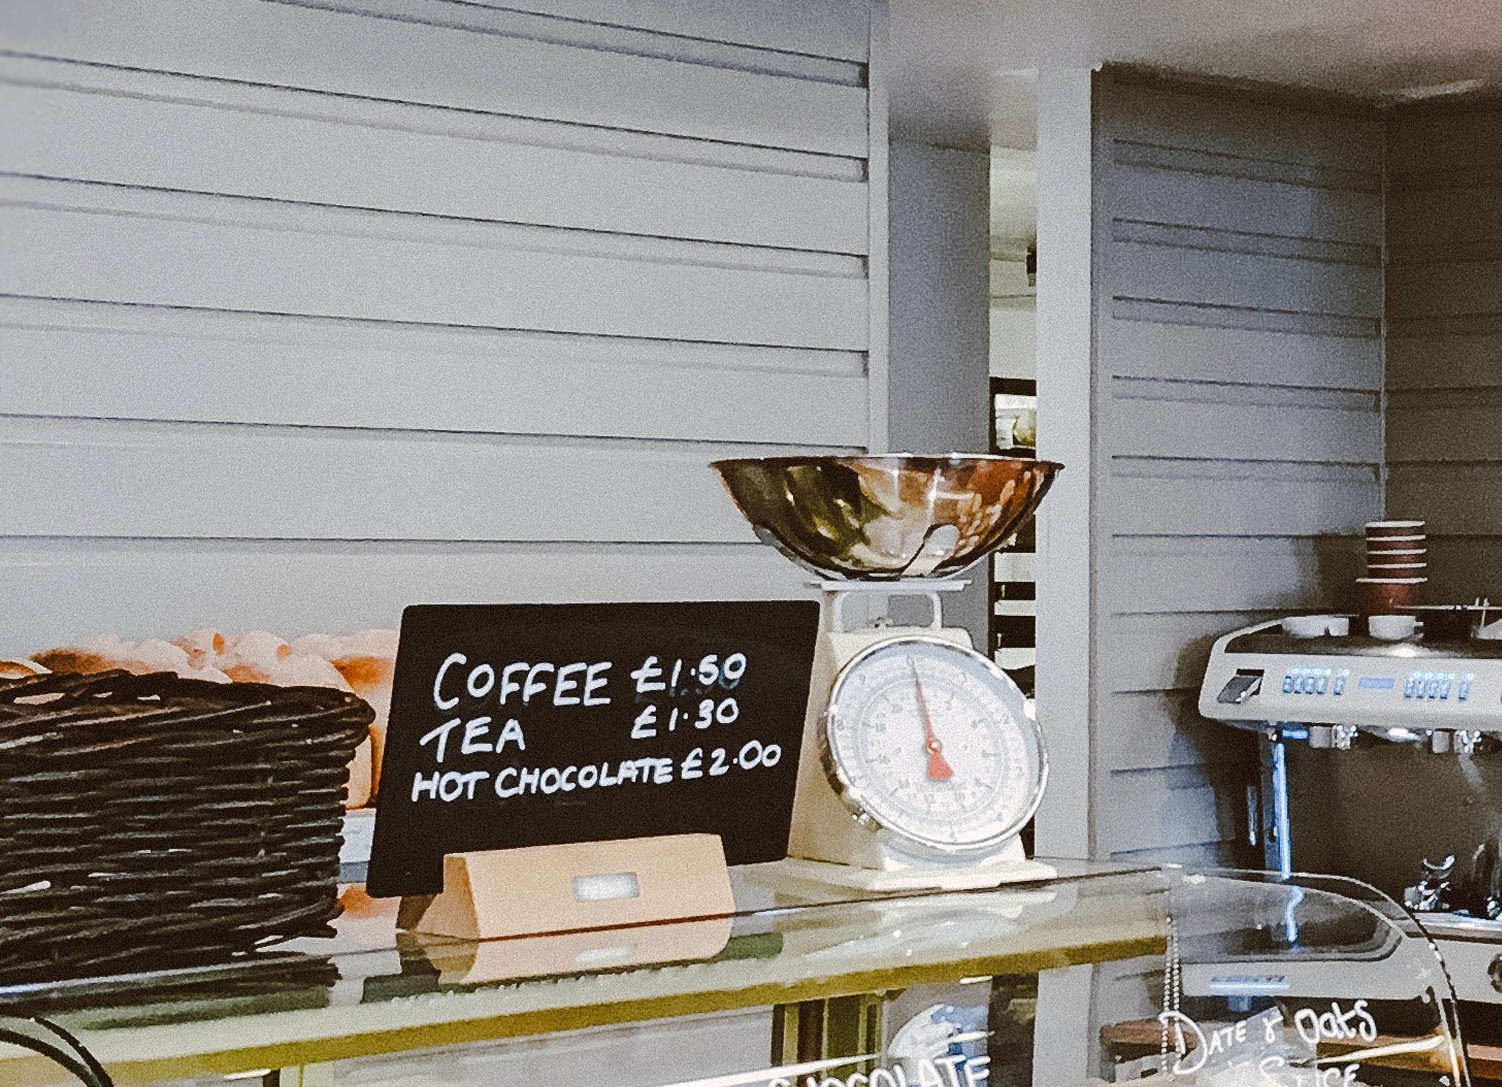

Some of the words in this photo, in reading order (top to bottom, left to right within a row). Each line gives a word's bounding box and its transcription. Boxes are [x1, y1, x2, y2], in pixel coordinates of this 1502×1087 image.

[433, 652, 613, 711] COFFEE
[419, 716, 526, 763] TEA
[411, 770, 490, 803] HOT
[494, 756, 675, 799] CHOCOLATE
[680, 739, 783, 780] £2.00
